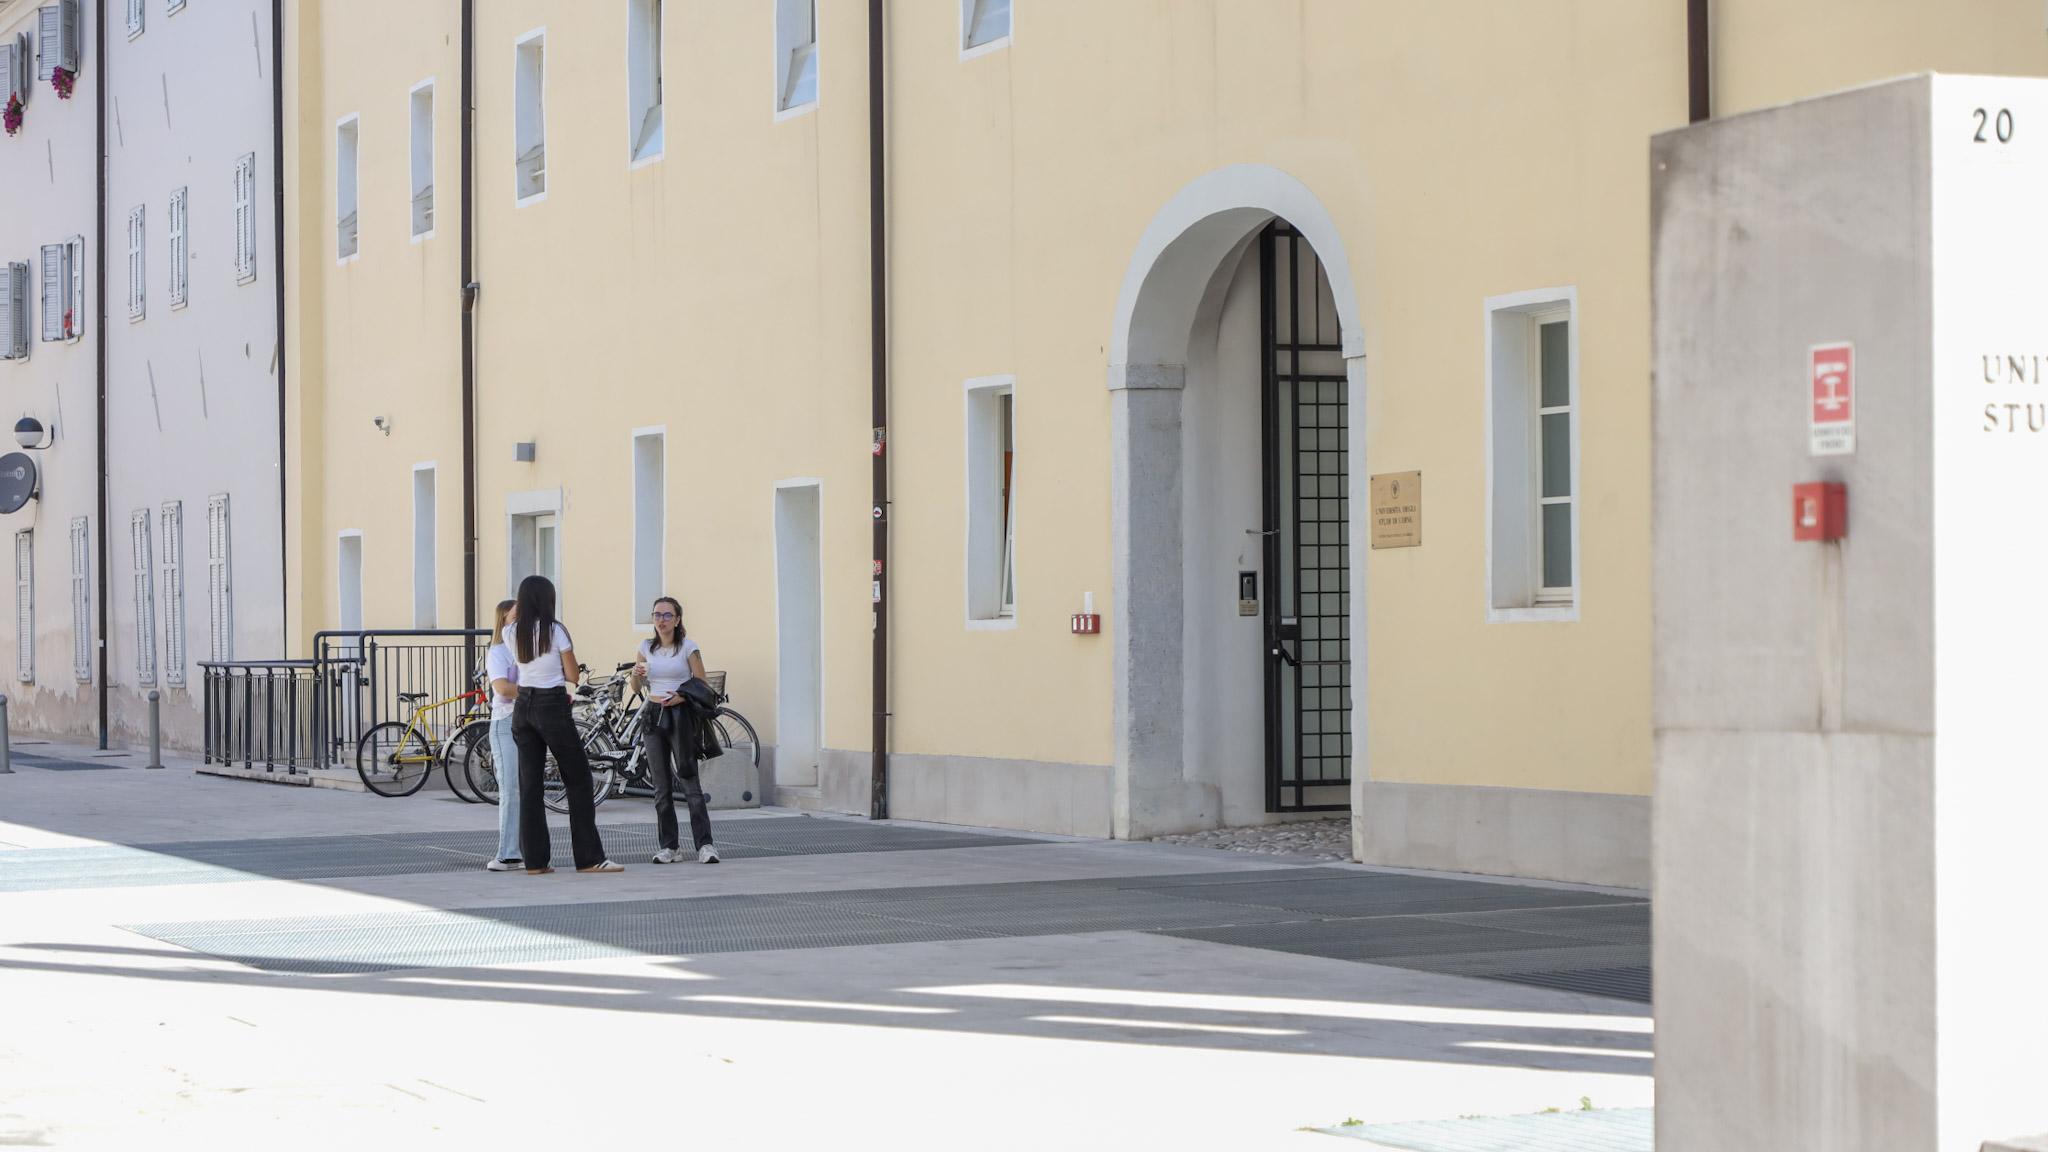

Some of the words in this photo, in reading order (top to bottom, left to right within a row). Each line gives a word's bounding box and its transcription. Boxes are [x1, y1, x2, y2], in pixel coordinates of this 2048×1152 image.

[1973, 108, 2013, 143] 20
[1982, 355, 2048, 384] UNI
[1983, 403, 2045, 432] STU
